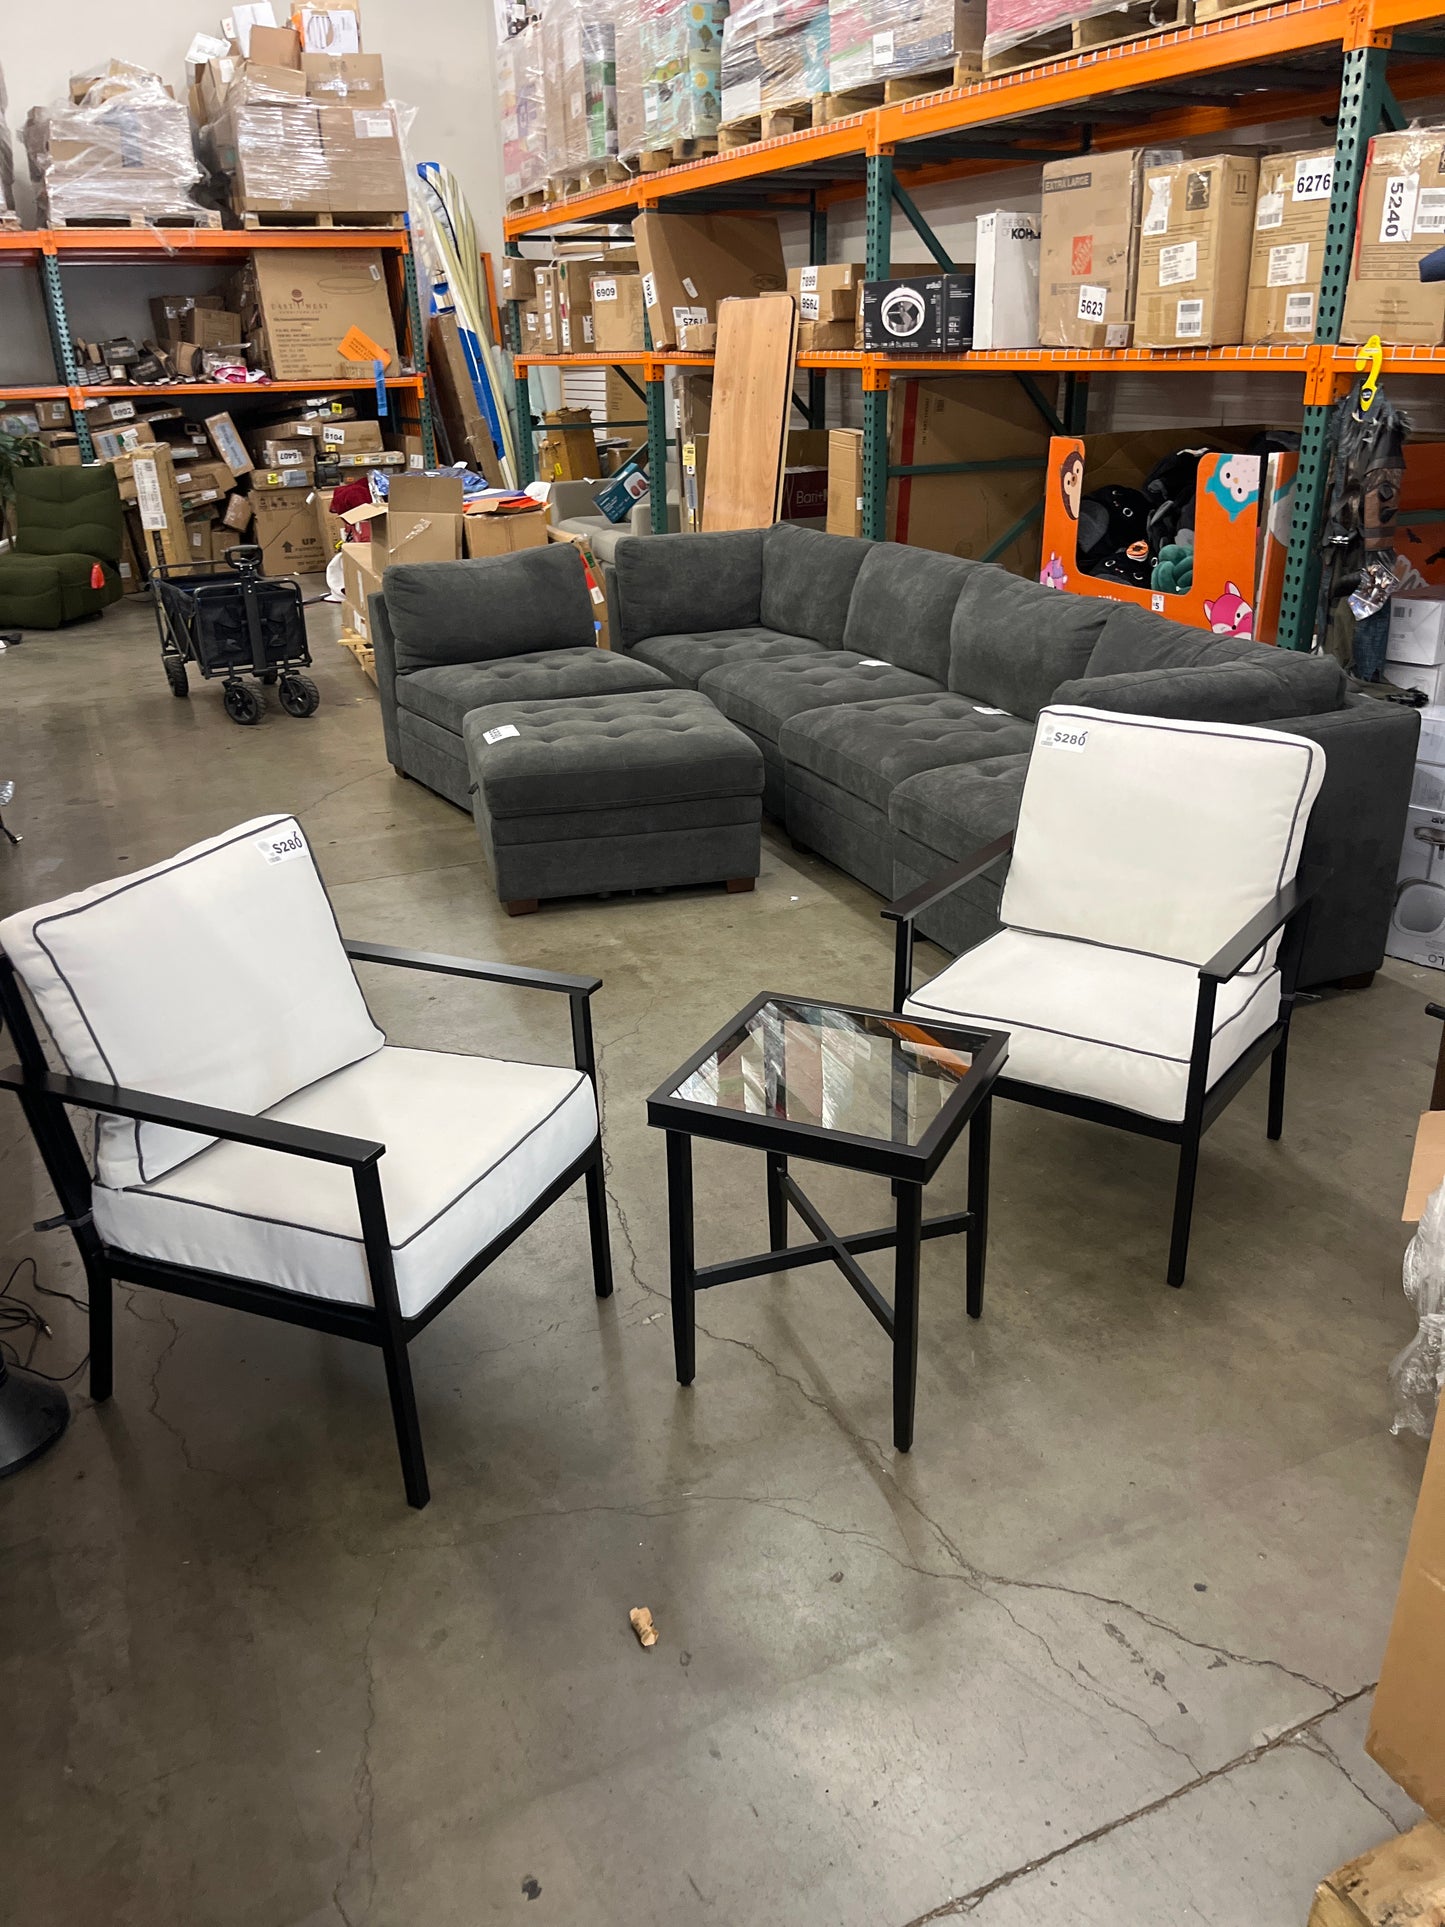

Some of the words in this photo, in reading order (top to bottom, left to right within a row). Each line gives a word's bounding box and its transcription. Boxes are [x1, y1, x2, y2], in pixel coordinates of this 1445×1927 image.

[1044, 177, 1066, 191] EXTRA
[1067, 174, 1090, 188] LARGE
[1296, 173, 1331, 194] 6276
[1384, 181, 1405, 238] 5240
[596, 287, 615, 297] 6909
[1080, 299, 1103, 317] 5623
[301, 538, 317, 546] UP
